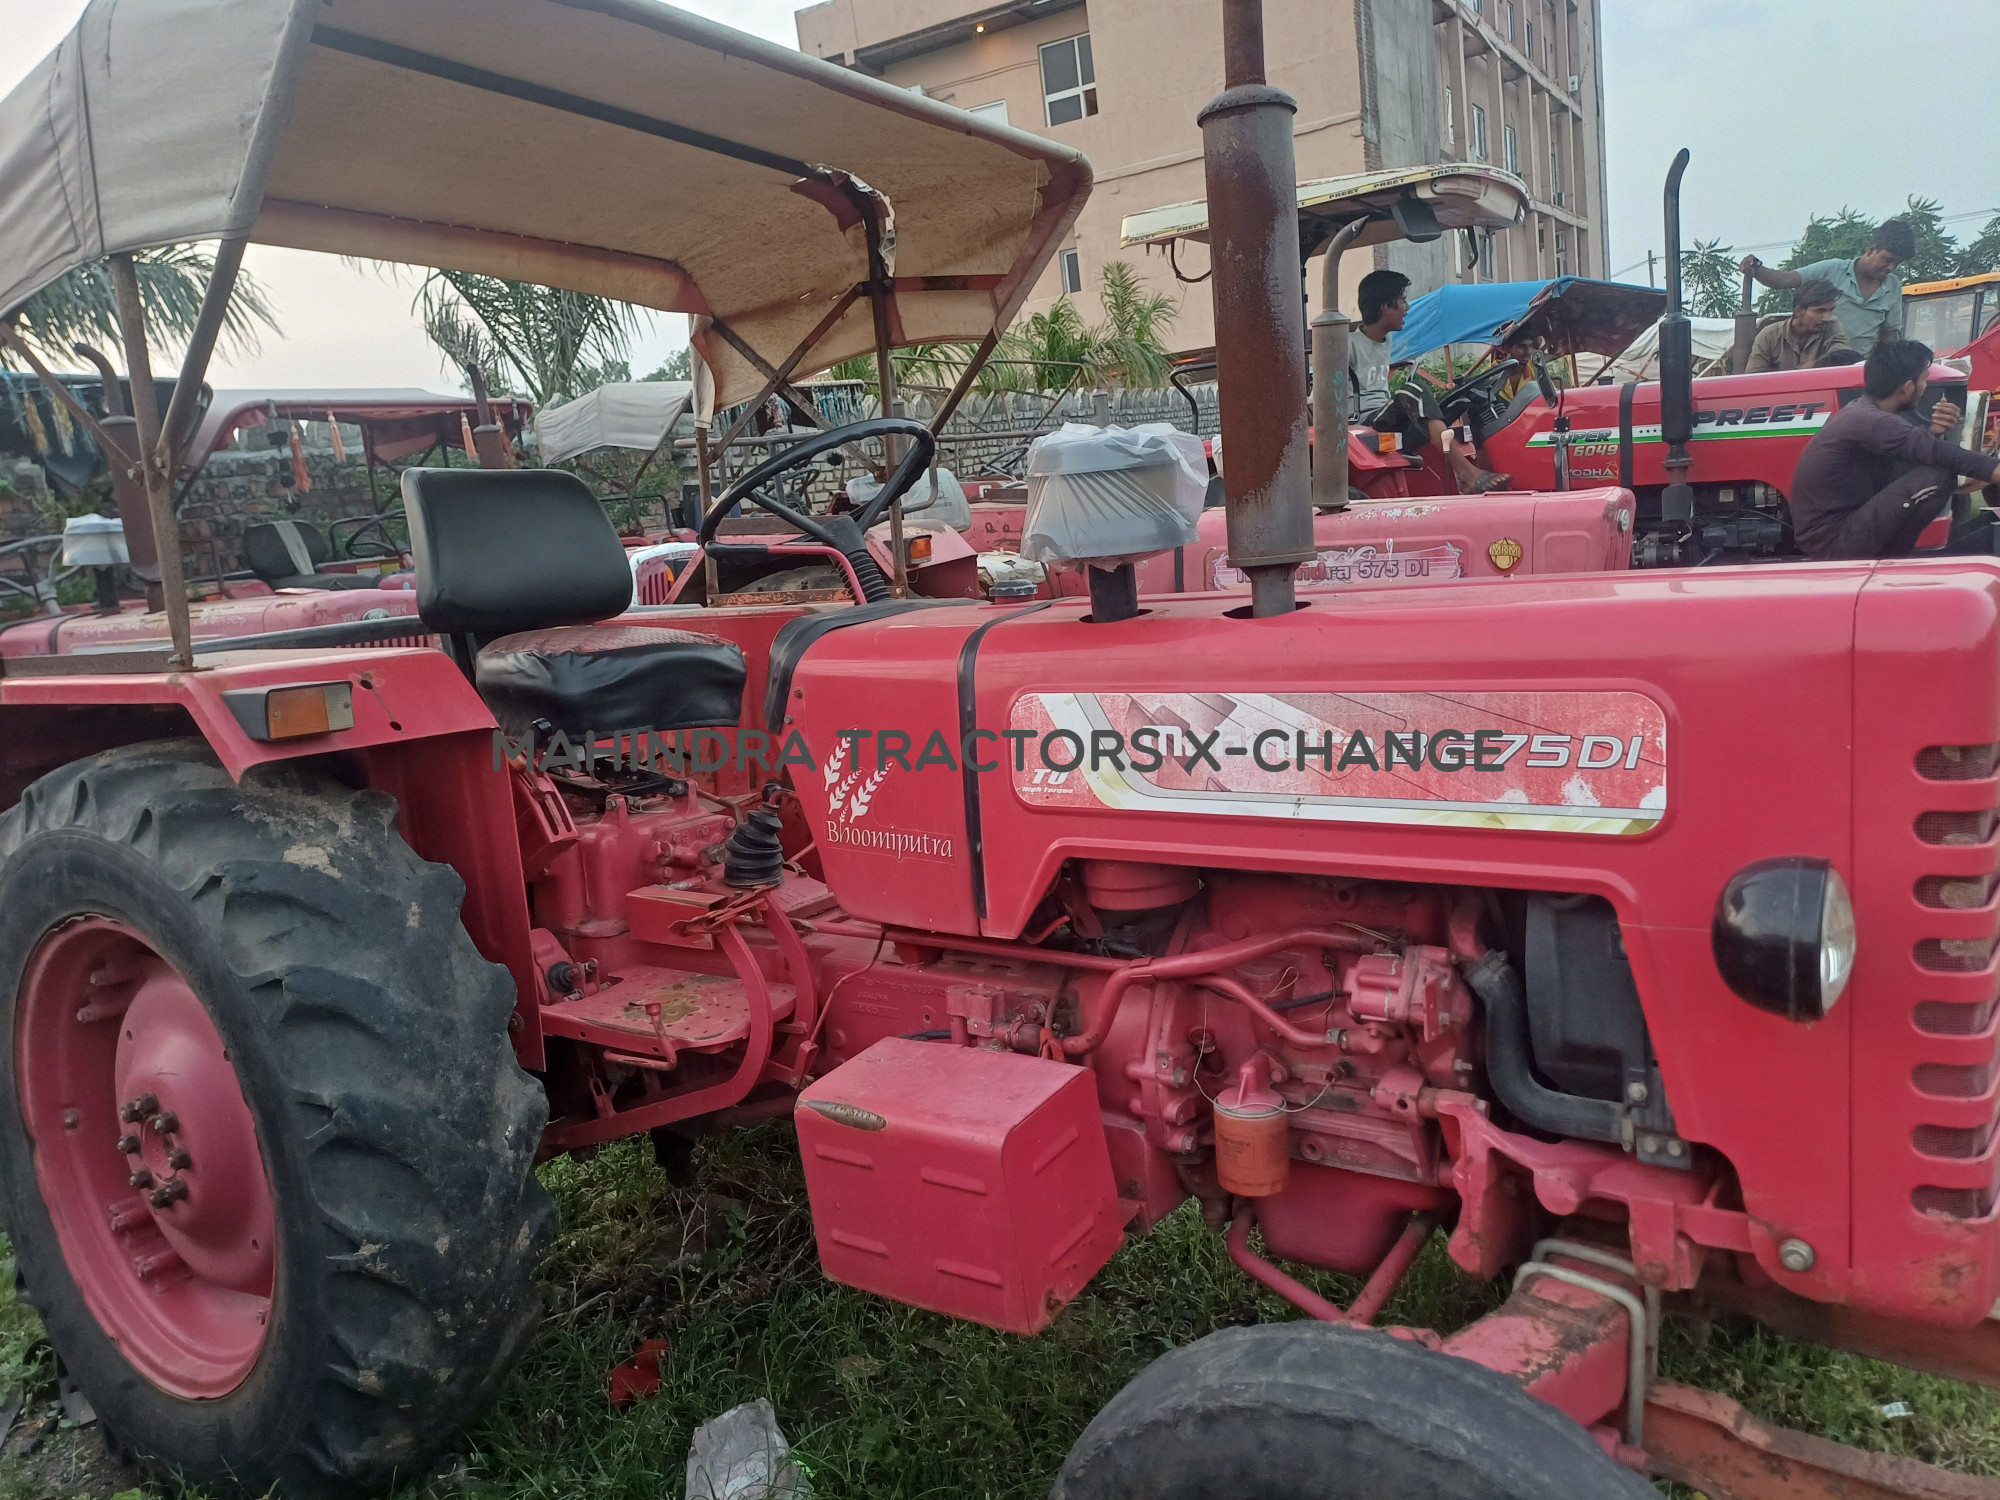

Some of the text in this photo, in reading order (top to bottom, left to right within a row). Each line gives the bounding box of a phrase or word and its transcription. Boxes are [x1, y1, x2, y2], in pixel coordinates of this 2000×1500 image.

[1328, 178, 1404, 200] PREET PREET
[1176, 222, 1204, 233] PREET
[1692, 402, 1825, 428] PREET
[1547, 430, 1612, 444] SUPER
[1573, 445, 1618, 456] 6049
[1570, 468, 1614, 477] ODHA
[1491, 544, 1519, 556] MKM
[1357, 558, 1399, 579] 575
[1405, 559, 1430, 576] DI
[1577, 735, 1643, 770] DI
[825, 819, 953, 860] Bhoomiputra
